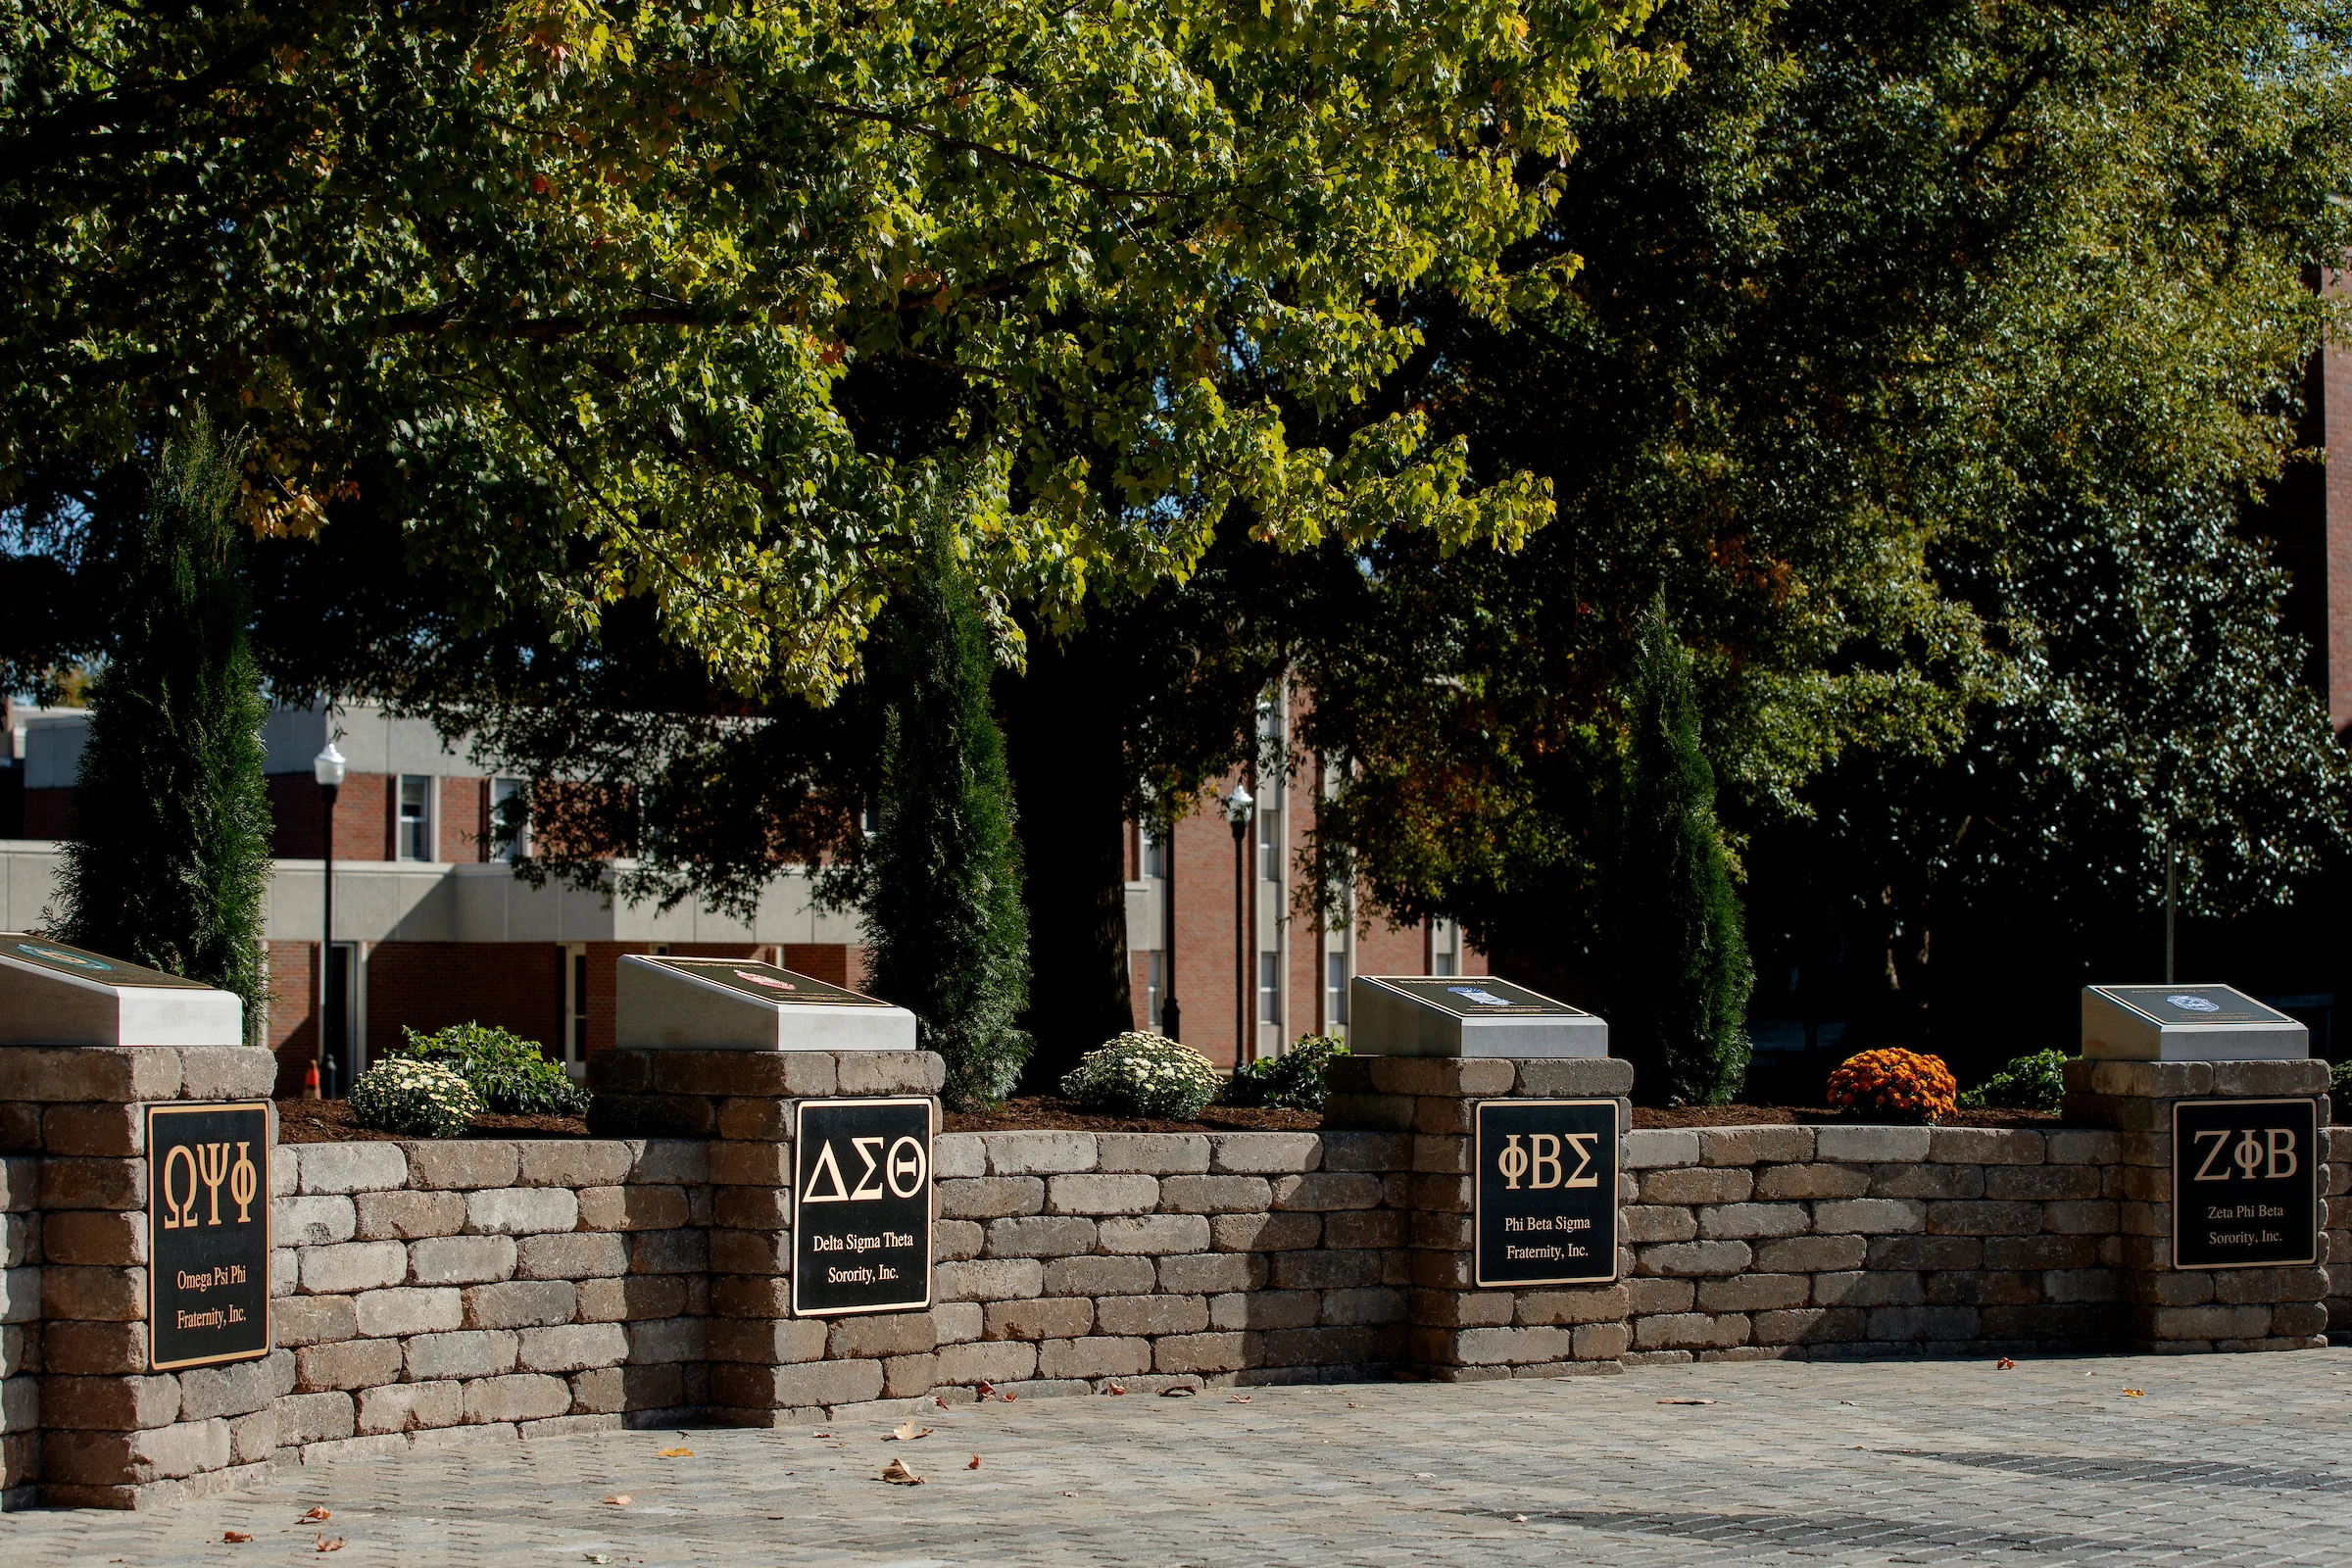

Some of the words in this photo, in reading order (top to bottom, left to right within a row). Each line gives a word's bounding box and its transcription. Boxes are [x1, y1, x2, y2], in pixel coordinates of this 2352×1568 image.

[1497, 1133, 1598, 1190] ΦΒΣ
[2193, 1129, 2298, 1181] ΖΦΒ
[802, 1136, 926, 1203] ΔΣΘ
[165, 1141, 258, 1230] ΩΨΦ
[2207, 1206, 2233, 1219] Zeta
[2235, 1205, 2255, 1218] Phi
[2258, 1204, 2284, 1217] Beta
[1504, 1217, 1524, 1232] Phi
[1526, 1216, 1552, 1231] Beta
[1555, 1215, 1591, 1233] Sigma
[812, 1235, 844, 1251] Delta
[846, 1234, 881, 1253] Sigma
[883, 1231, 914, 1248] Theta
[2209, 1232, 2259, 1246] Sorority,
[2261, 1230, 2283, 1243] Inc.
[1506, 1245, 1565, 1261] Fraternity,
[1567, 1243, 1589, 1257] Inc.
[177, 1270, 212, 1292] Omega
[214, 1266, 228, 1286] Psi
[230, 1264, 247, 1284] Phi
[828, 1266, 876, 1285] Sorority,
[878, 1264, 900, 1280] Inc.
[176, 1307, 226, 1330] Fraternity,
[228, 1303, 247, 1323] Inc.
